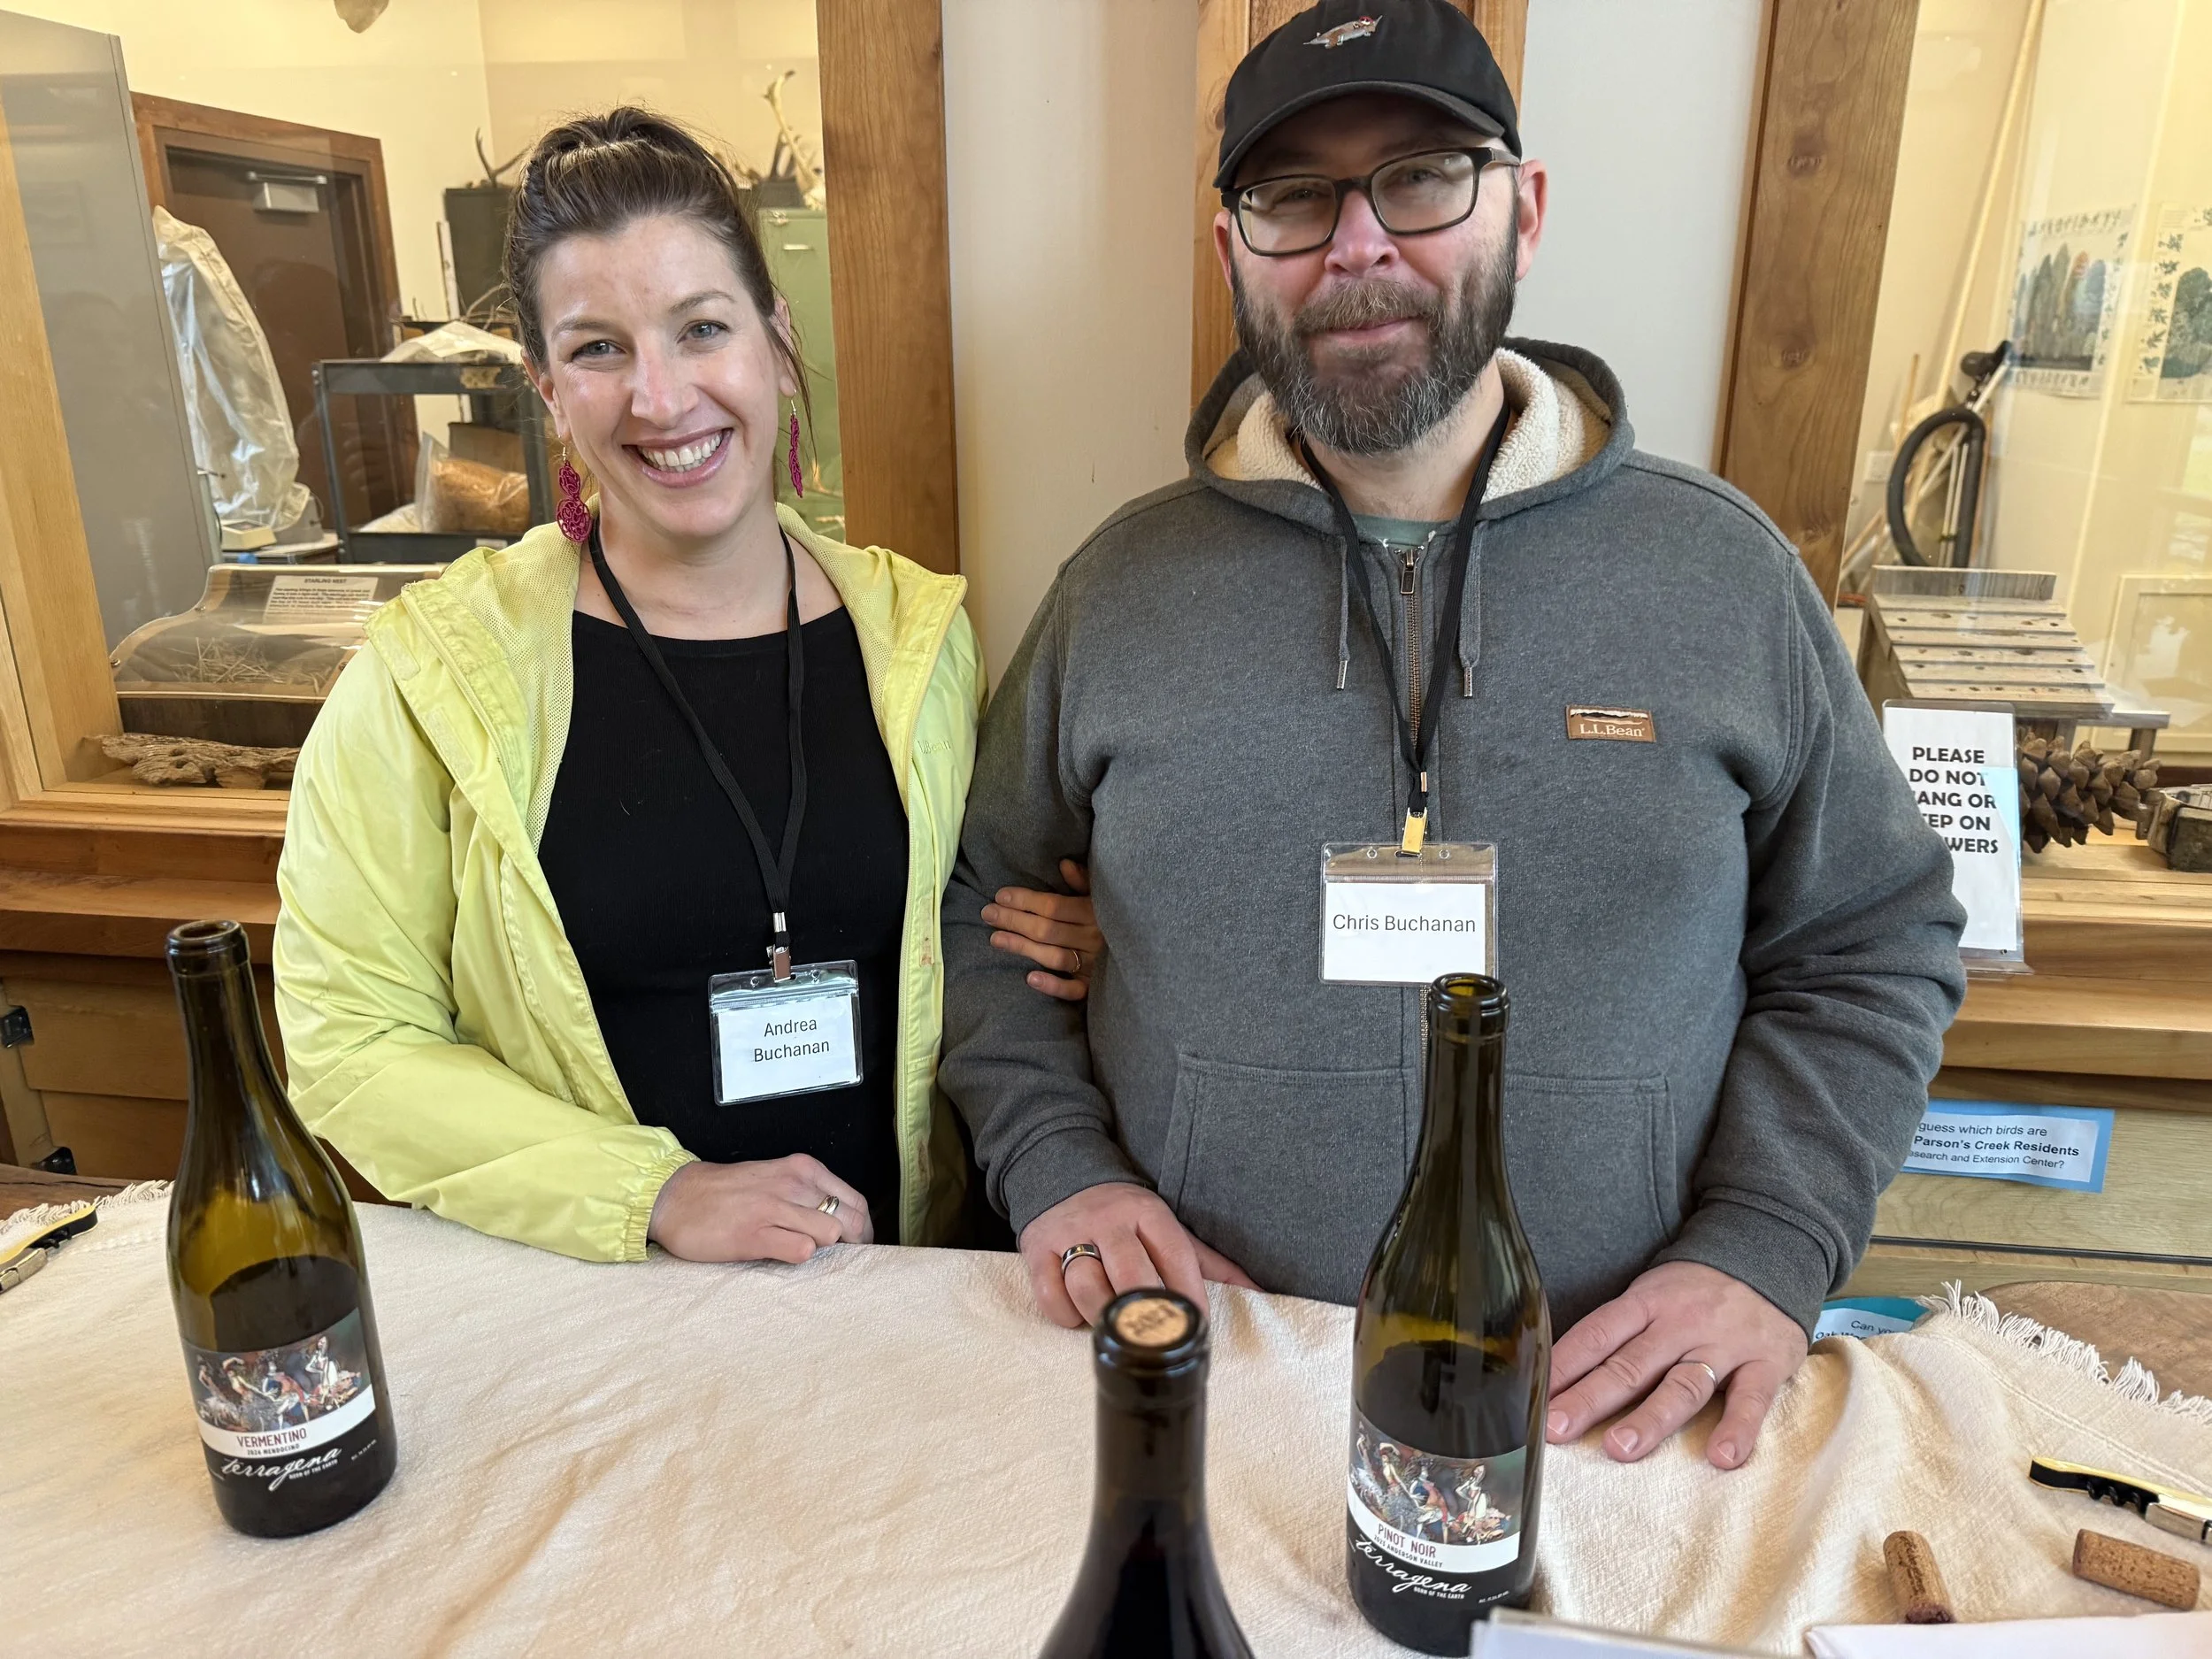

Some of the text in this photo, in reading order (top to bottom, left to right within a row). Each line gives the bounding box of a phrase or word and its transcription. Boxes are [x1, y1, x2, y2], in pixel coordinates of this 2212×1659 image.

[1912, 746, 1985, 764] PLEASE
[1909, 768, 1988, 787] DO NOT
[1912, 790, 1997, 809] ANG OR
[1922, 813, 1991, 831] EP ON
[1333, 914, 1476, 932] Chris Buchanan
[764, 1019, 818, 1037] Andrea
[754, 1041, 830, 1062] Buchanan
[1918, 1122, 2047, 1137] guess which birds are
[1914, 1135, 2079, 1156] Parson's Creek Residents
[1950, 1154, 1970, 1163] and
[1972, 1155, 2020, 1164] Extension
[2023, 1156, 2065, 1169] Center?
[1850, 1320, 1874, 1331] Can
[237, 1428, 307, 1448] VERMENTINO
[264, 1443, 300, 1455] MENDOCINO
[1378, 1523, 1406, 1548] PINOT
[1410, 1540, 1437, 1558] NOIR
[1386, 1544, 1418, 1562] ANDERSON
[1419, 1557, 1443, 1568] VALLEY
